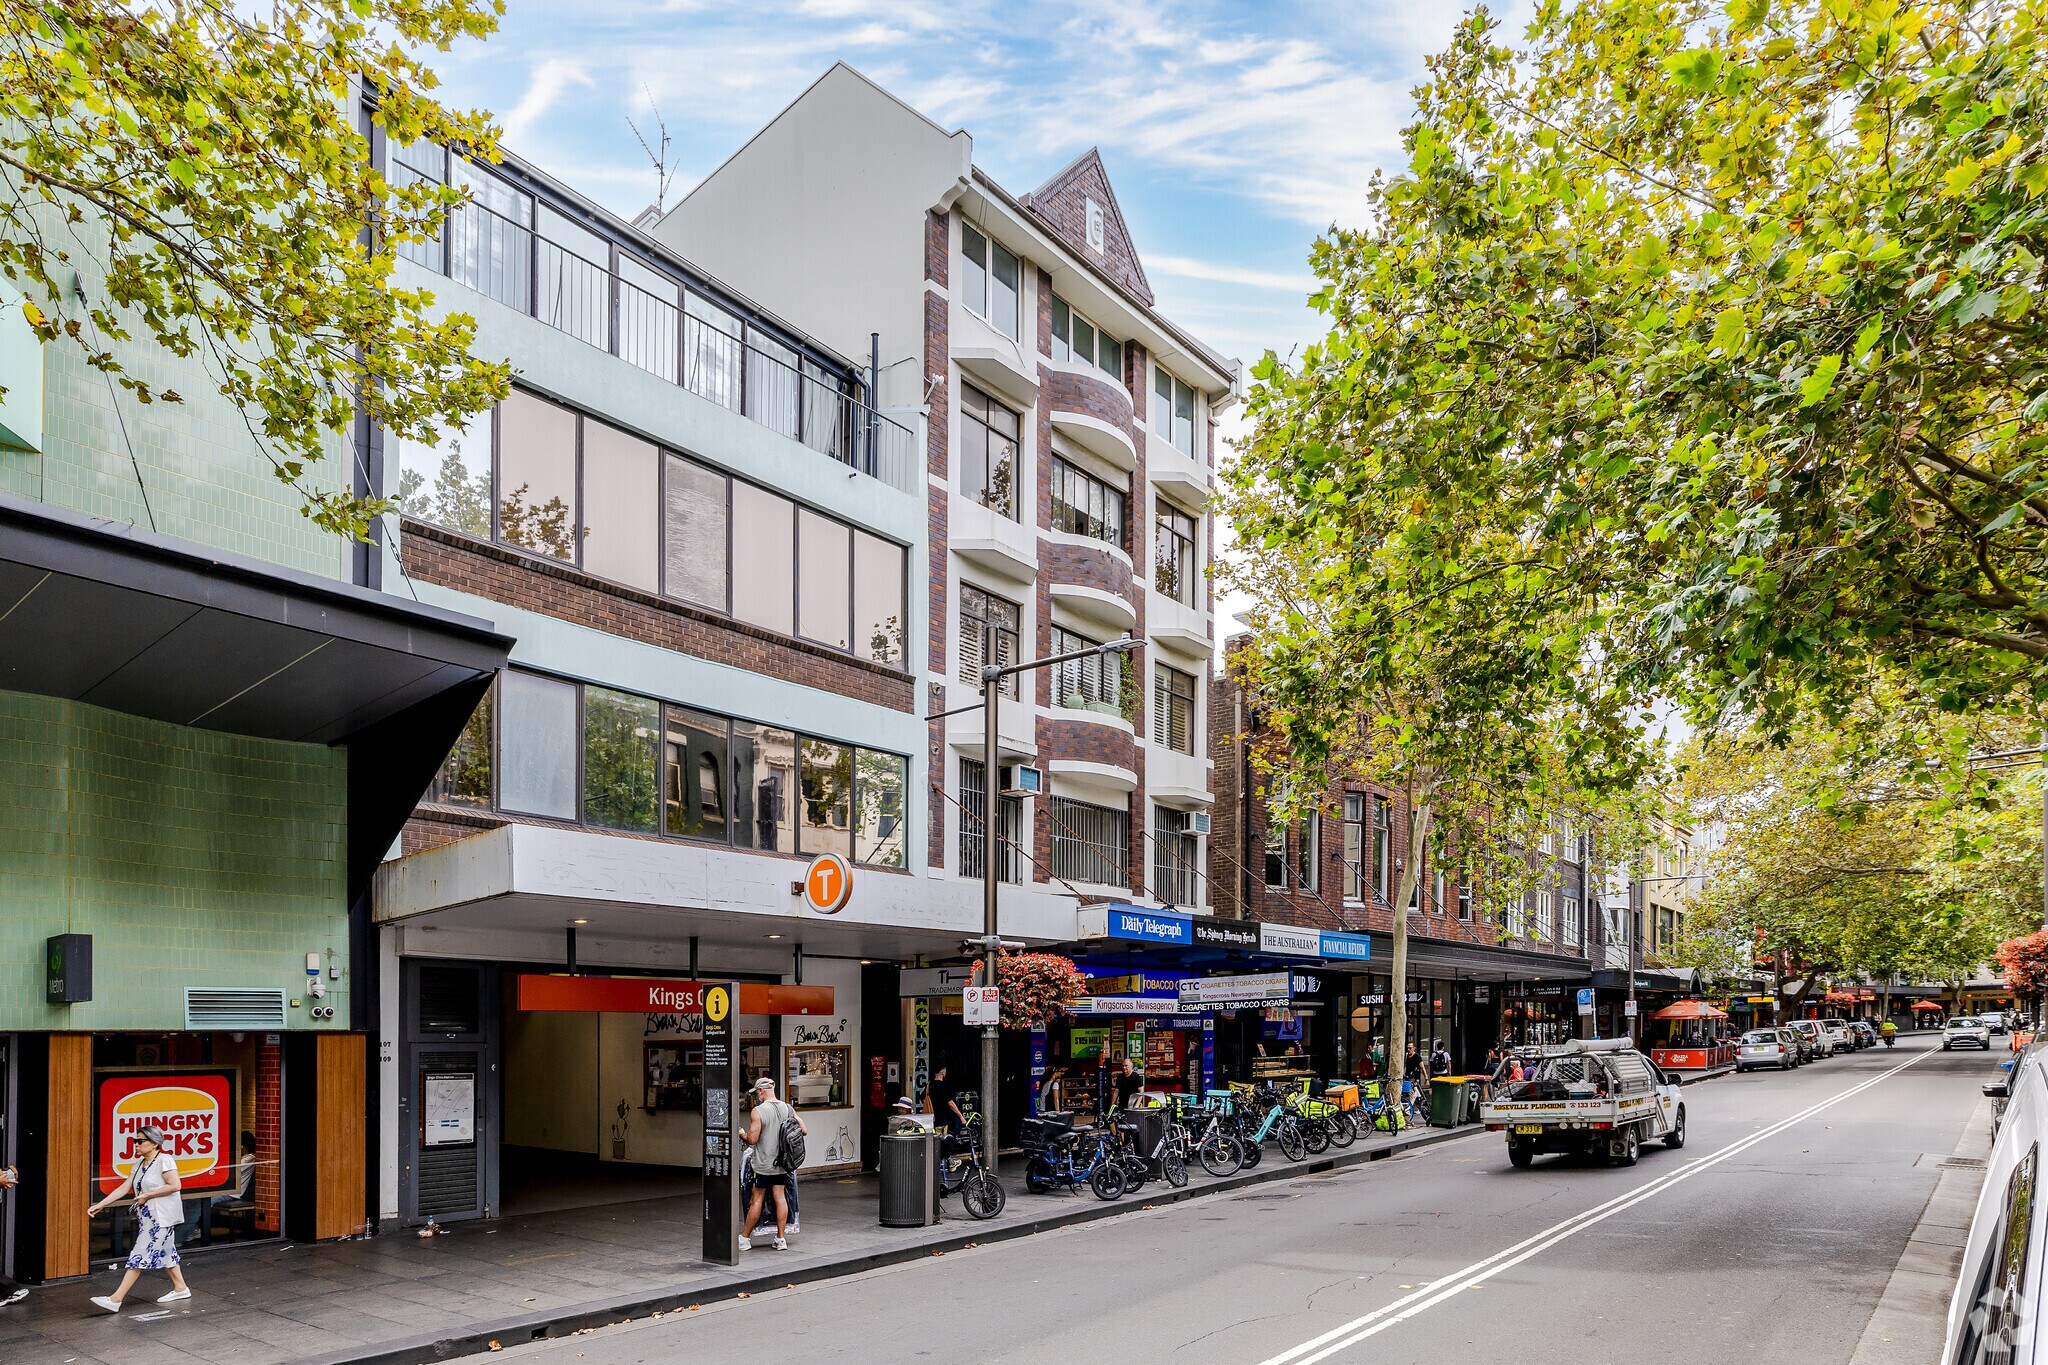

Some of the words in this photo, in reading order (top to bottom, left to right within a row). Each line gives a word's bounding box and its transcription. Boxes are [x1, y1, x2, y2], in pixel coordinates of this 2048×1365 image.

[816, 868, 834, 901] T
[1121, 915, 1144, 935] Daily
[1144, 918, 1182, 938] Telegraph
[1196, 927, 1207, 940] The
[1207, 928, 1224, 943] Sydney
[1224, 930, 1243, 943] Morning
[1242, 932, 1257, 945] Herald
[1264, 935, 1277, 947] THE
[1278, 938, 1314, 950] AUSTRALIAN
[1323, 940, 1347, 954] FINANCIAL
[1348, 943, 1367, 956] REVIEW
[49, 978, 64, 993] Metro
[1096, 982, 1121, 995] TRAVEL
[1143, 979, 1174, 990] TOBACCO
[1180, 982, 1200, 991] CTC
[1201, 980, 1235, 989] CIGARETTES
[1236, 979, 1265, 987] TOBACCO
[649, 987, 694, 1010] Kings
[1181, 1002, 1224, 1011] CIGARETTES
[1226, 1001, 1260, 1009] TOBACCO
[1261, 999, 1290, 1007] CIGARS
[1360, 995, 1384, 1004] SUSHI
[1096, 1000, 1134, 1013] Kingscross
[1136, 1001, 1175, 1012] Newsagency
[1145, 1018, 1158, 1028] CTC
[1172, 1019, 1201, 1027] TOBACCONIST
[1493, 1103, 1529, 1111] ROSEVILLE
[1530, 1102, 1567, 1110] PLUMBING
[118, 1113, 214, 1134] HUNGRY
[118, 1131, 214, 1160] JCK'S
